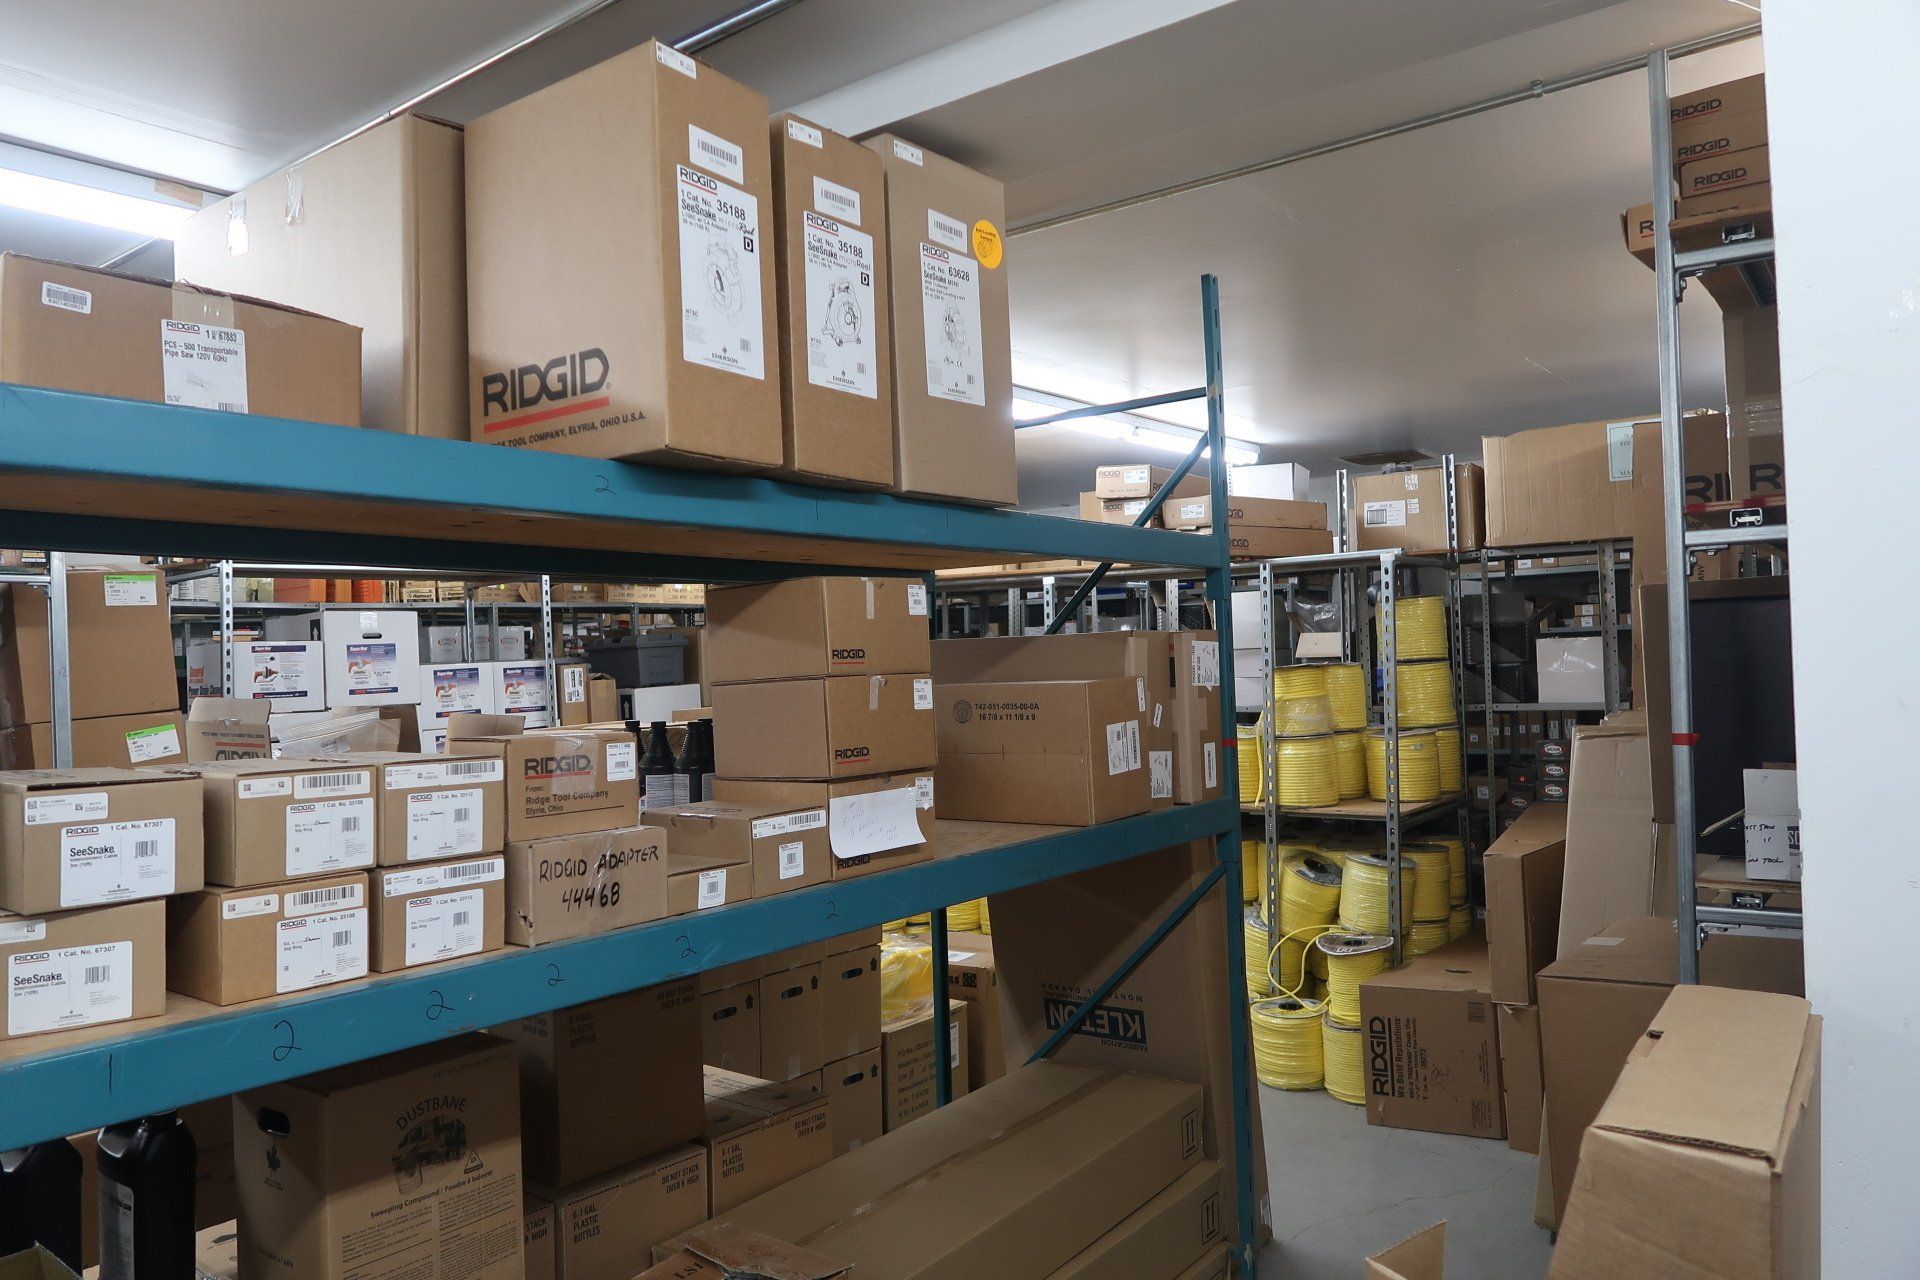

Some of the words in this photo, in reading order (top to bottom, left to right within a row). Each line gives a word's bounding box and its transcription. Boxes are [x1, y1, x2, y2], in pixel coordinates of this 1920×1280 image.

[1671, 99, 1722, 120] RIDGID
[1678, 138, 1730, 158] RIDGID
[679, 167, 718, 190] RIDGID
[1694, 168, 1747, 187] RIDGID
[681, 199, 716, 221] SeeSnake
[686, 191, 699, 203] Cat.
[702, 197, 712, 208] No.
[717, 200, 746, 221] 35188
[806, 213, 839, 233] RIDGID
[807, 241, 838, 260] SeeSnake
[813, 234, 824, 245] Cat.
[825, 239, 834, 248] No.
[838, 240, 863, 259] 35188
[922, 244, 950, 260] RIDGID
[923, 270, 947, 285] SeeSnake
[927, 262, 936, 271] Cat.
[948, 266, 970, 282] 63628
[166, 321, 201, 332] RIDGID
[164, 340, 177, 349] PCS
[184, 343, 196, 352] 500
[197, 343, 239, 357] Transportable
[164, 349, 179, 358] Pipe
[180, 351, 194, 359] Saw
[196, 352, 211, 361] 120V
[212, 353, 228, 363] 60Hz
[711, 352, 739, 366] EMERSON
[482, 347, 611, 418] RIDGID
[832, 375, 856, 386] EMERSON
[946, 387, 967, 396] EMERSON
[508, 435, 527, 448] TOOL
[528, 428, 567, 445] COMPANY,
[568, 421, 598, 436] ELYRIA,
[600, 416, 620, 429] OHIO
[622, 410, 647, 425] U.S.A.
[1098, 470, 1121, 479] RIDGID
[595, 474, 617, 495] 2
[1103, 503, 1123, 512] RIDGID
[832, 648, 866, 660] RIDGID
[978, 713, 987, 721] 16
[987, 713, 998, 721] 7/8
[1013, 713, 1025, 721] 1/8
[835, 746, 870, 760] RIDGID
[524, 754, 593, 776] RIDGID
[525, 785, 544, 793] From:
[525, 795, 550, 806] Ridge
[552, 793, 571, 802] Tool
[572, 789, 609, 801] Company
[411, 794, 433, 802] RIDGID
[290, 804, 315, 813] RIDGID
[525, 806, 547, 817] Elyria,
[547, 805, 564, 813] Ohio
[66, 826, 99, 836] RIDGID
[115, 824, 129, 832] Cat.
[144, 820, 163, 829] 67307
[69, 844, 115, 858] SeeSnake
[539, 858, 588, 883] RIDGID
[597, 844, 659, 874] ADAPTER
[837, 852, 872, 870] RIDGID
[409, 897, 432, 907] RIDGID
[561, 881, 620, 912] 44468
[826, 900, 840, 920] 2
[281, 919, 307, 928] RIDGID
[94, 945, 116, 954] 67307
[674, 935, 697, 959] 2
[14, 952, 50, 963] RIDGID
[14, 972, 62, 986] SeeSnake
[547, 963, 567, 987] 2
[1041, 983, 1081, 995] CANADA
[425, 990, 455, 1021] 2
[273, 1019, 302, 1062] 2
[1100, 1040, 1149, 1053] FABRICATION
[1394, 1017, 1405, 1062] Reputations
[1369, 1016, 1389, 1096] RIDGID
[1395, 1064, 1405, 1085] Build
[1396, 1087, 1405, 1098] We
[396, 1095, 468, 1131] DUSTBANE
[794, 1120, 801, 1131] DO
[801, 1118, 811, 1127] NOT
[811, 1111, 826, 1124] STACK
[722, 1153, 743, 1168] PLASTIC
[661, 1173, 670, 1185] DO
[670, 1170, 681, 1182] NOT
[682, 1163, 699, 1178] STACK
[722, 1163, 744, 1179] BOTTLES
[666, 1182, 680, 1194] OVER
[687, 1173, 700, 1187] HIGH
[370, 1200, 403, 1219] Sweeping
[404, 1188, 440, 1208] Compound
[444, 1178, 466, 1194] Poudre
[584, 1203, 598, 1217] GAL.
[525, 1216, 547, 1233] STACK
[573, 1213, 600, 1232] PLASTIC
[531, 1228, 547, 1242] HIGH
[573, 1225, 601, 1245] BOTTLES
